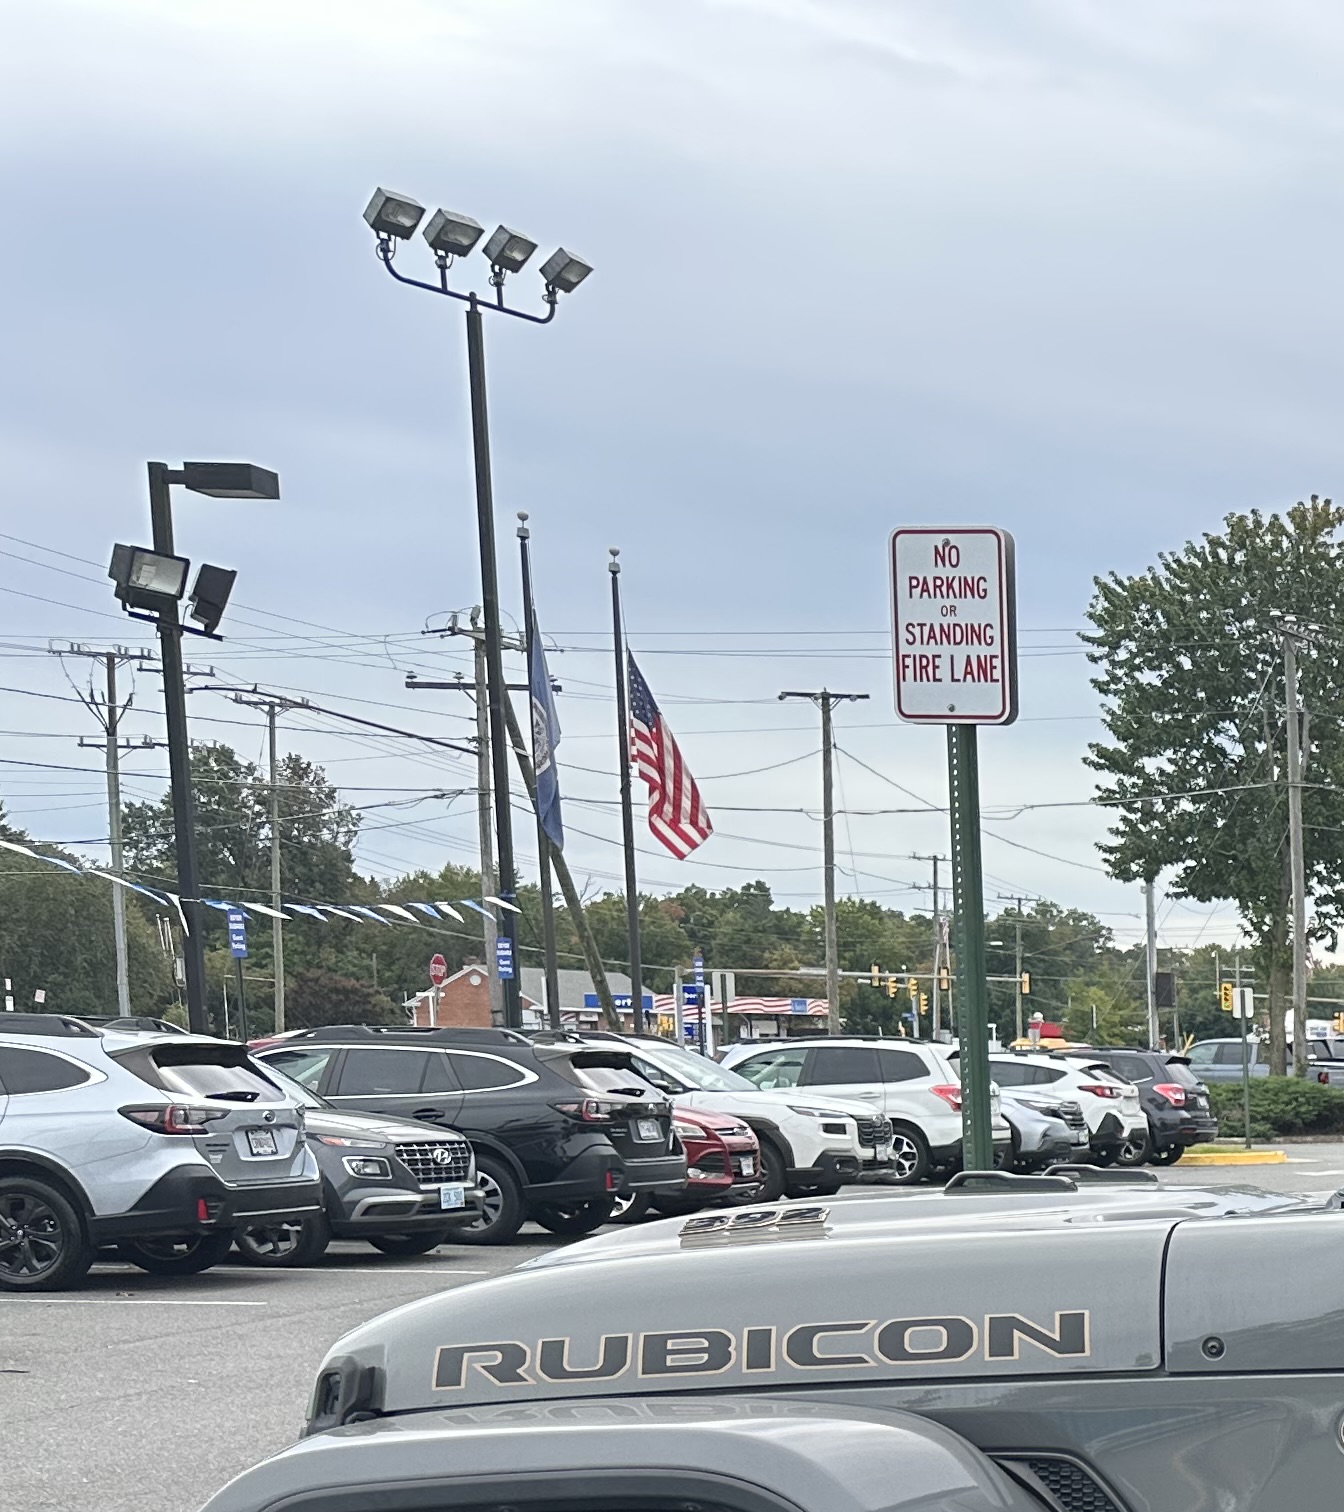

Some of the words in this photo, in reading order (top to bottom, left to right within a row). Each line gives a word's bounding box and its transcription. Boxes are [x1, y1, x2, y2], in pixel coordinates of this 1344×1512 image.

[934, 544, 961, 569] NO
[908, 576, 988, 600] PARKING
[940, 605, 958, 618] OR
[905, 623, 995, 647] STANDING
[901, 654, 943, 683] FIRE
[950, 655, 1000, 683] LANE
[431, 1308, 1091, 1391] RUBICON
